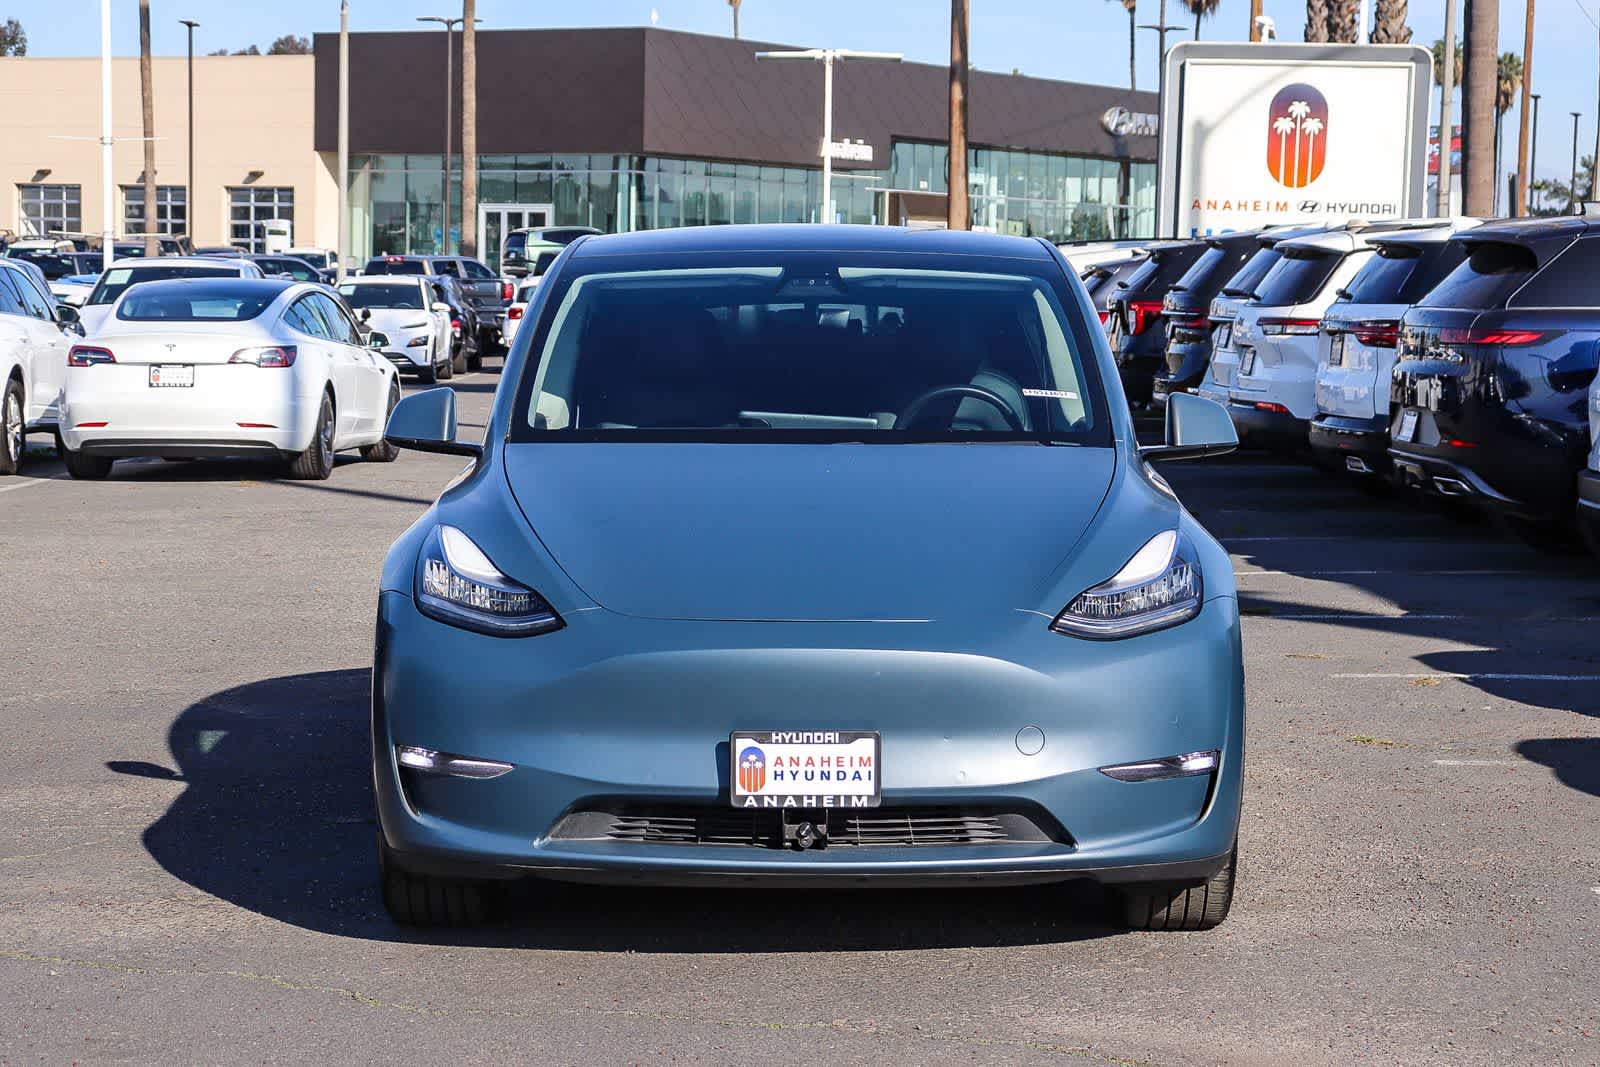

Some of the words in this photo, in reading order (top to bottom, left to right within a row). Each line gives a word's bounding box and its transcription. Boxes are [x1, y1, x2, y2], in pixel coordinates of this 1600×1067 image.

[1192, 199, 1288, 212] ANAHEIM
[1326, 202, 1396, 214] HYUNDAI
[771, 732, 839, 744] HYUNDAI
[774, 756, 872, 768] ANAHEIM
[774, 770, 871, 781] HYUNDAI
[744, 796, 867, 808] ANAHEIM
